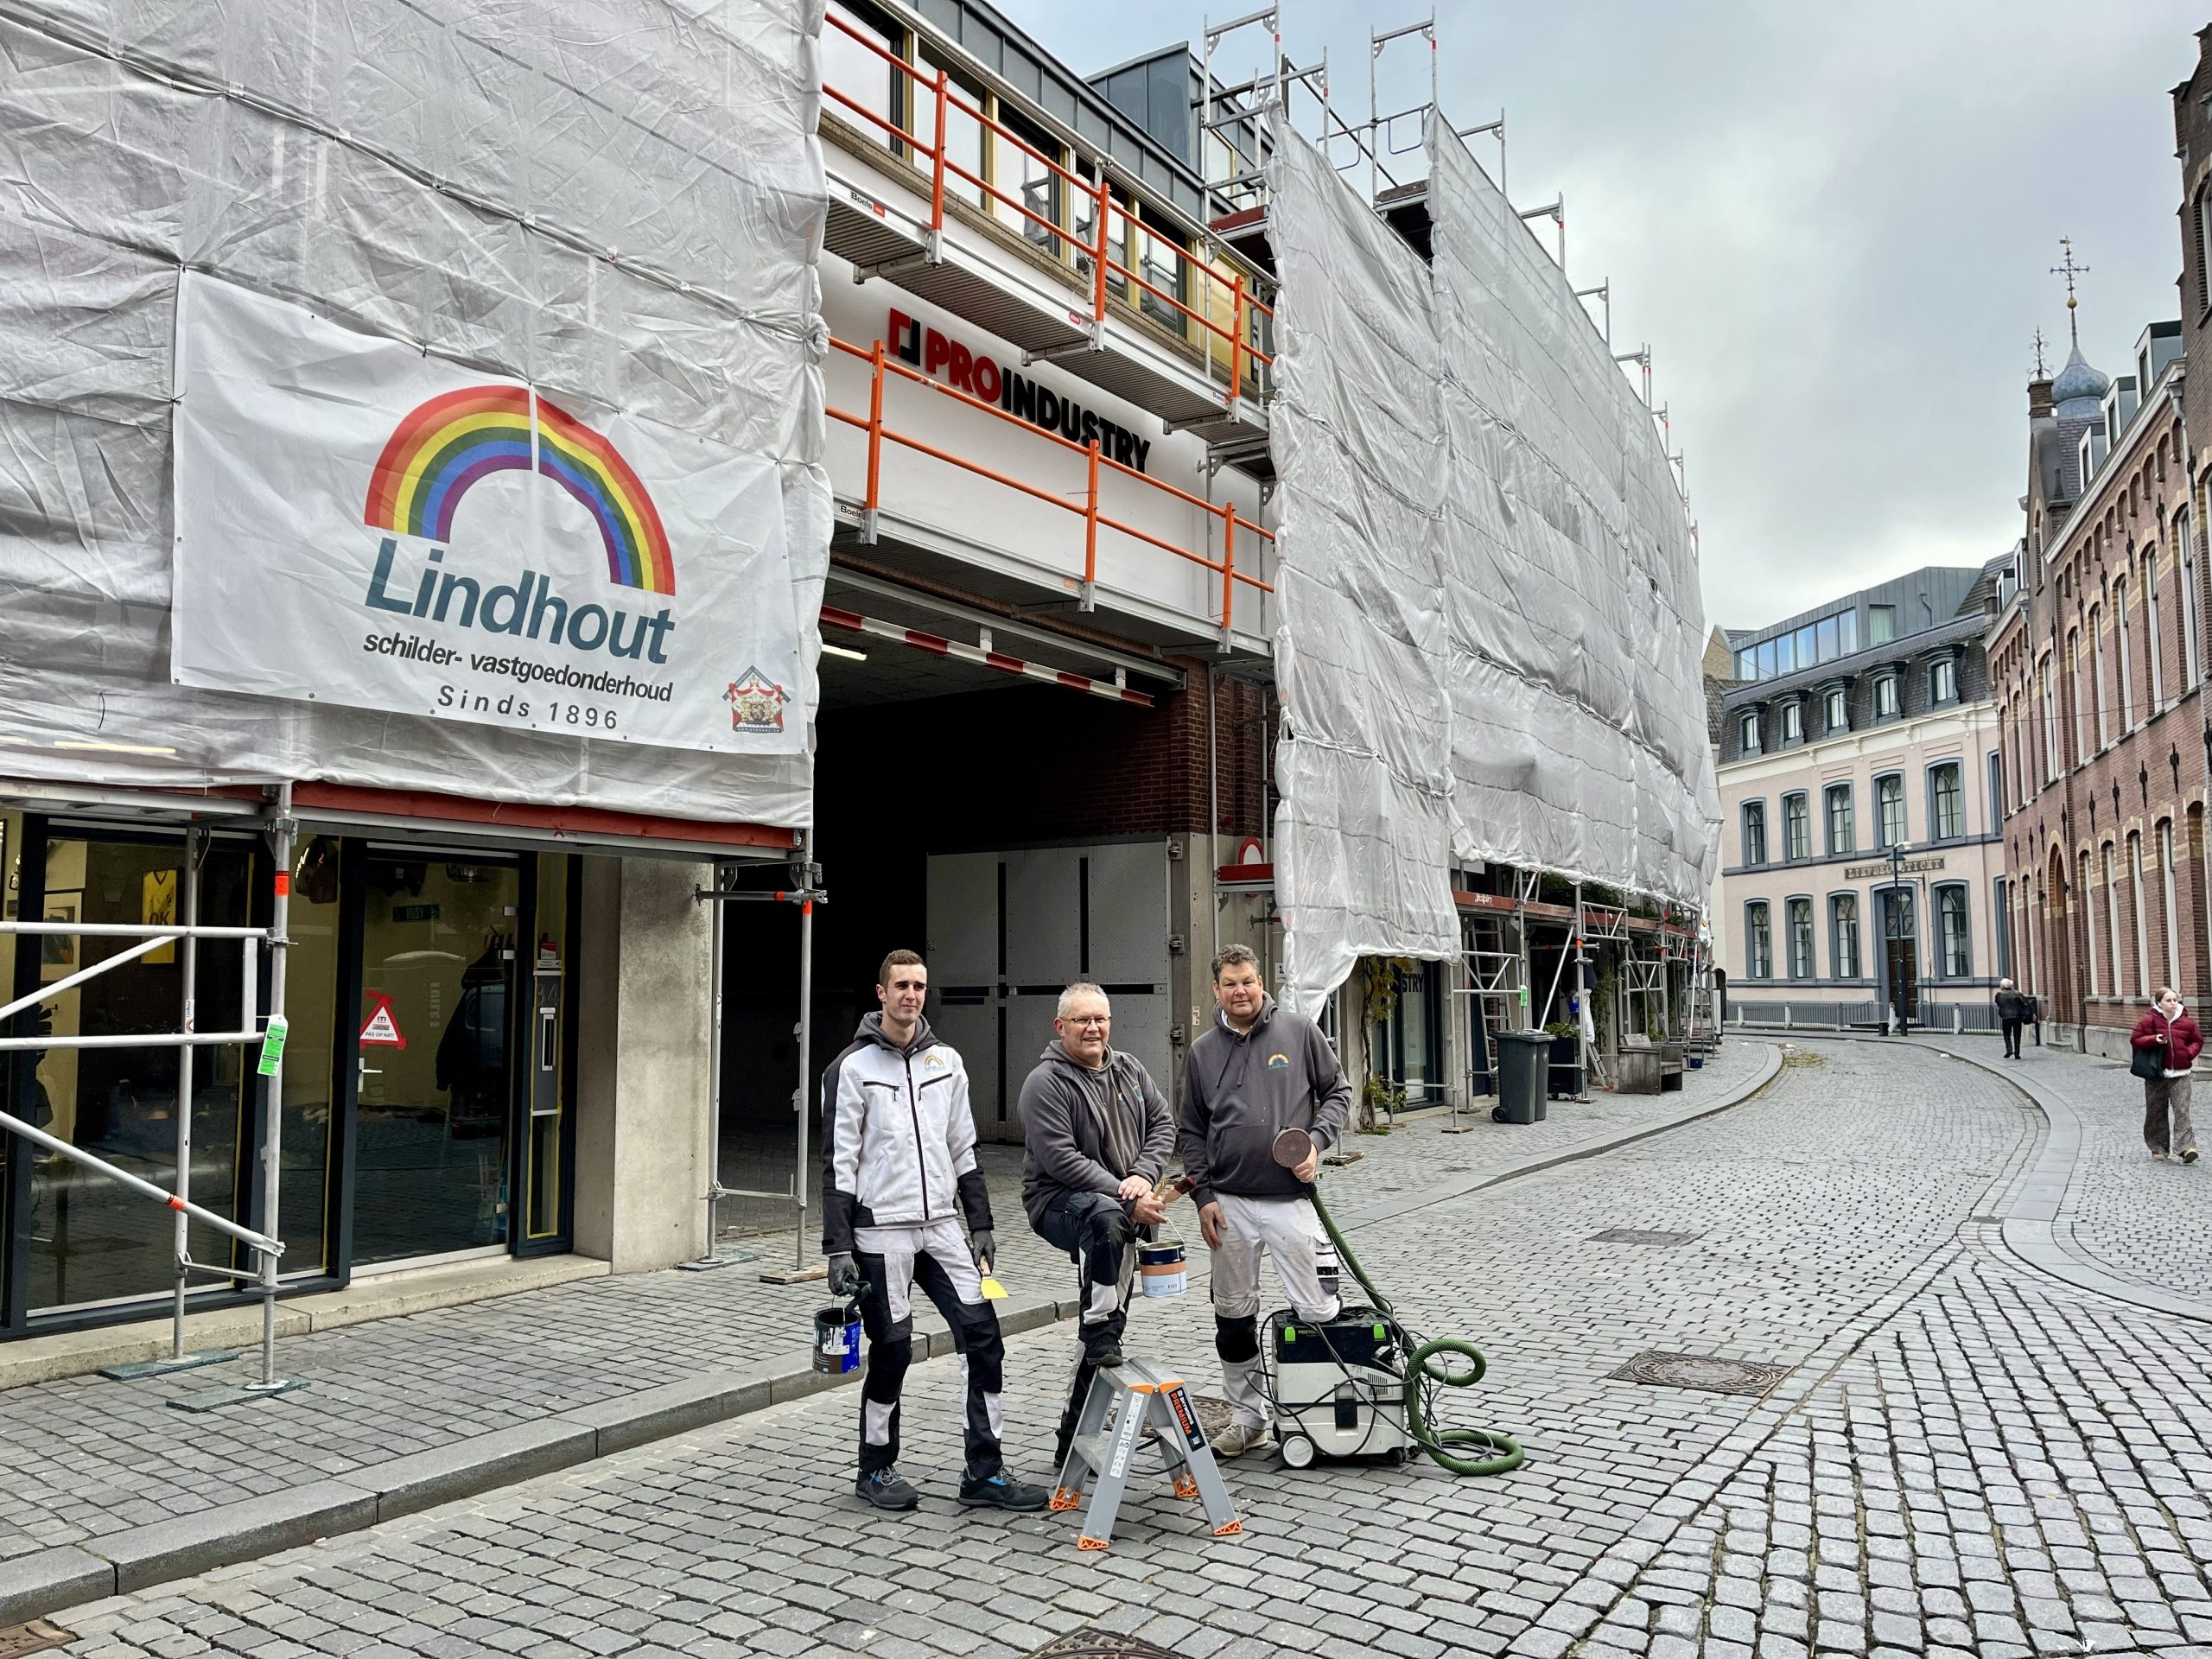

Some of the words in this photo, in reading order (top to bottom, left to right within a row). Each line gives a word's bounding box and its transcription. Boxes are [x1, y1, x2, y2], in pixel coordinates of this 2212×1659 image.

[850, 191, 873, 209] Boels
[925, 327, 1152, 474] PROINDUSTRY
[365, 537, 676, 664] Lindhout
[363, 632, 463, 667] schilder-
[470, 652, 674, 702] vastgoedonderhoud
[437, 684, 531, 717] Sinds
[550, 702, 618, 730] 1896
[1847, 861, 1940, 878] LIEFDETICHT
[1170, 1392, 1192, 1435] PREMIUM
